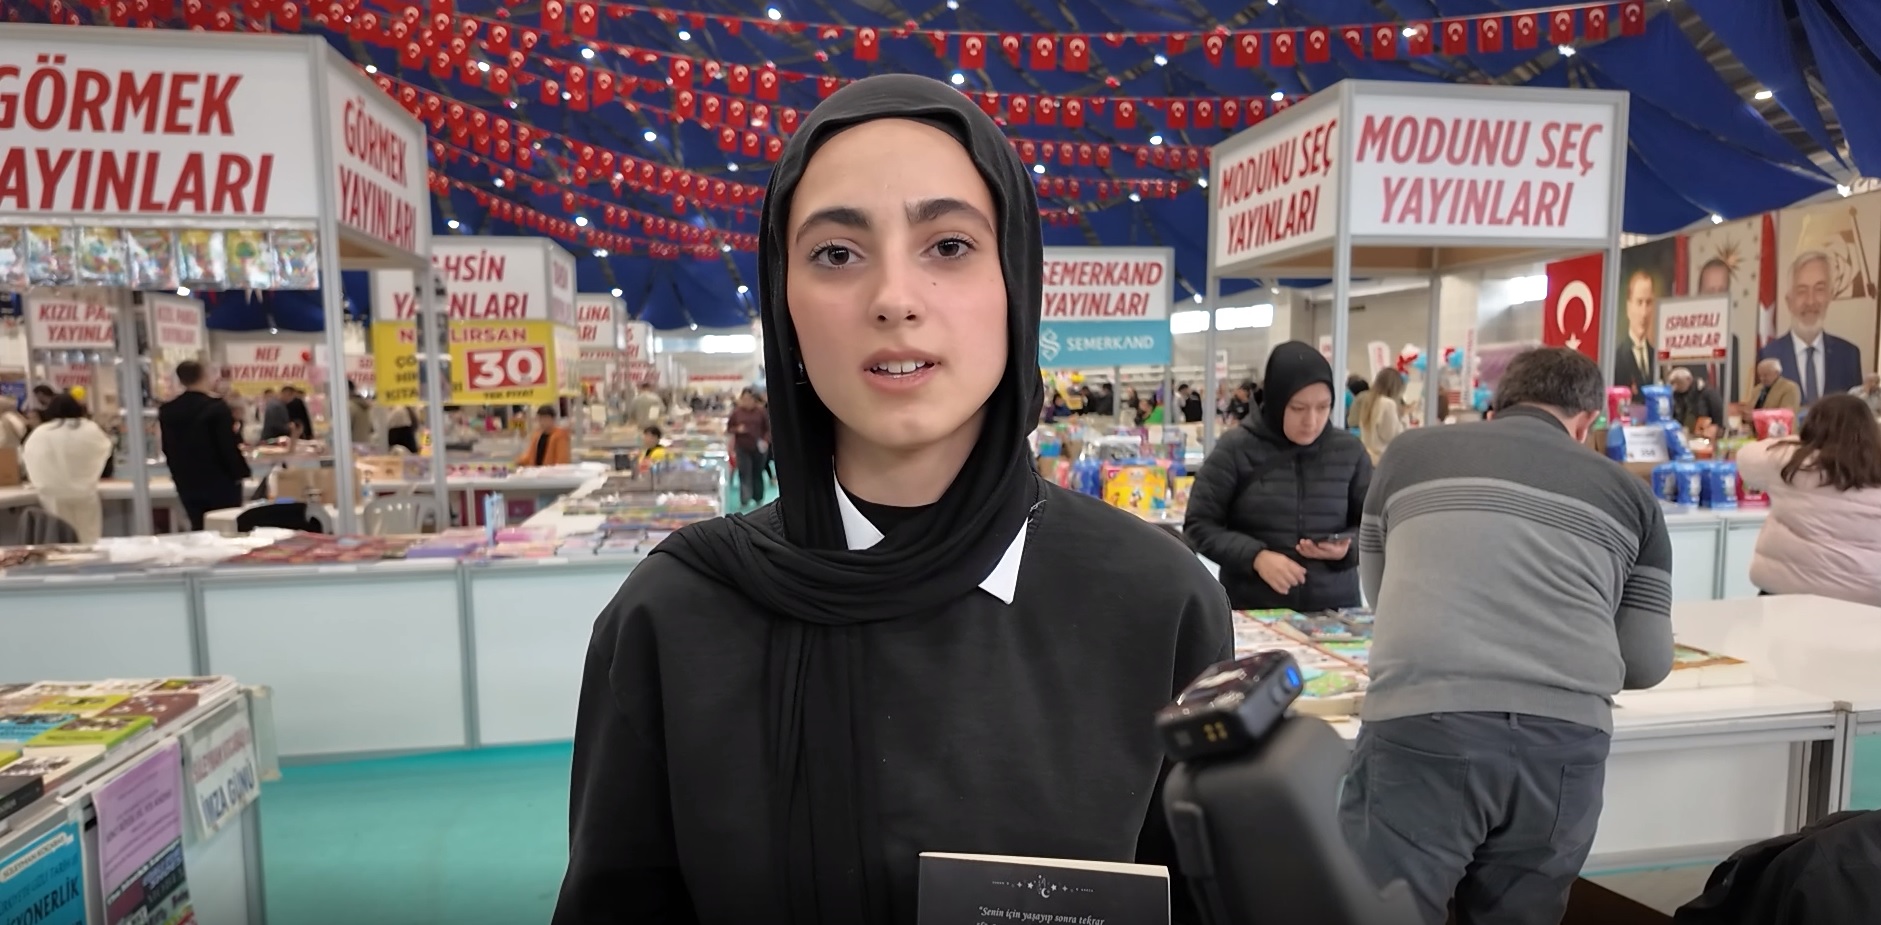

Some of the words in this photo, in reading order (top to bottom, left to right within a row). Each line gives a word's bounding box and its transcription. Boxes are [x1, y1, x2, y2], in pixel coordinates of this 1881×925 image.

[343, 95, 408, 188] GÖRMEK
[1218, 137, 1296, 210] MODUNU
[1297, 118, 1338, 177] SEÇ
[1356, 115, 1532, 166] MODUNU
[1535, 122, 1604, 176] SEÇ
[0, 147, 274, 213] AYINLARI
[338, 163, 416, 253] YAYINLARI
[1381, 176, 1575, 227] YAYINLARI
[1226, 184, 1321, 255] YAYINLARI
[431, 249, 506, 283] HSİN
[1044, 292, 1150, 317] YAYINLARI
[472, 348, 543, 388] 30
[1066, 336, 1154, 351] SEMERKAND
[1006, 909, 1021, 920] için
[1022, 911, 1053, 924] yaşayıp
[1055, 914, 1077, 924] sonra
[1079, 915, 1105, 925] tekrar
